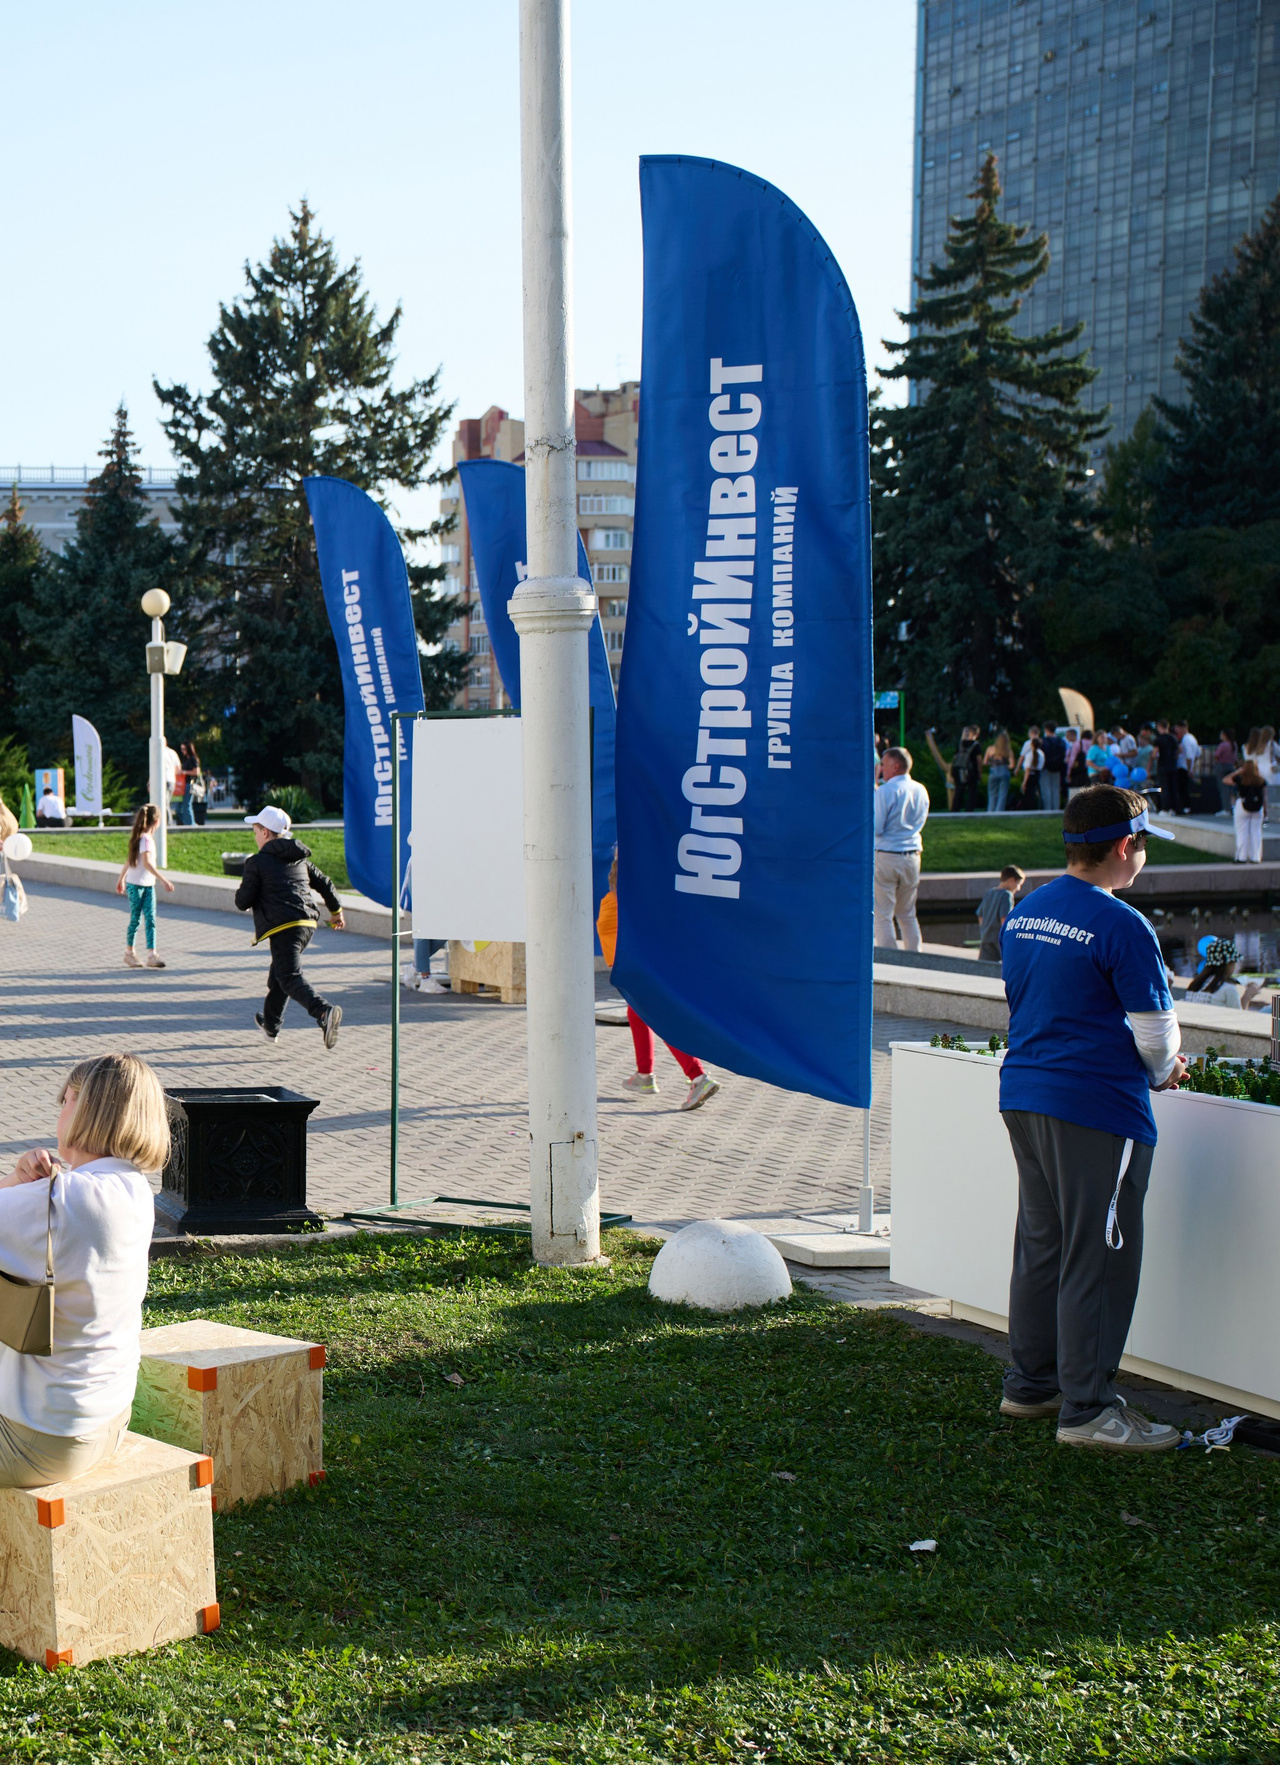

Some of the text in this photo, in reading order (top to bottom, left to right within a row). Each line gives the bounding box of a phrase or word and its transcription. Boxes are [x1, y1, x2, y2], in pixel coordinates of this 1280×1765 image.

[341, 568, 393, 827] ЮгСтройИнвест
[370, 627, 396, 704] КОМПАНИЙ
[674, 357, 763, 899] ЮгСтройИнвест
[768, 486, 799, 770] ГРУППА КОМПАНИЙ
